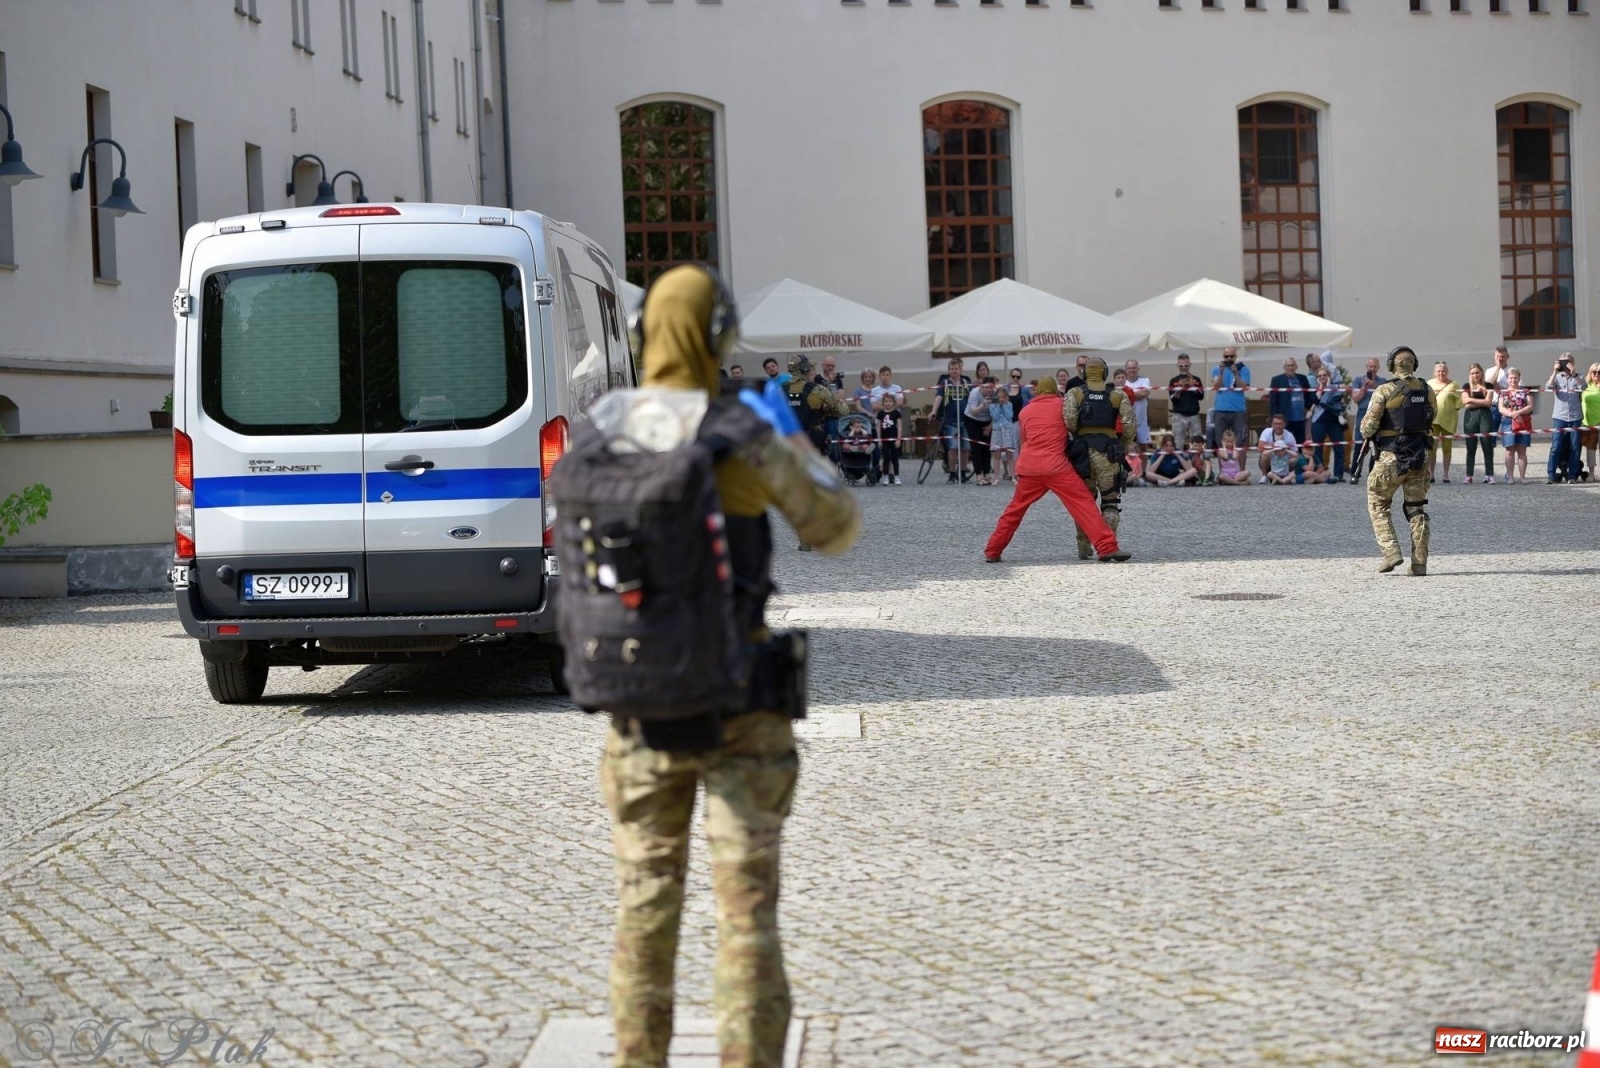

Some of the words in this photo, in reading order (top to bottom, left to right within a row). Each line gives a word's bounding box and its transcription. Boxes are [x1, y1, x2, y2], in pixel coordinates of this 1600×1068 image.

[248, 465, 321, 473] TRANSIT
[256, 577, 282, 594] SZ
[288, 575, 343, 593] 0999J
